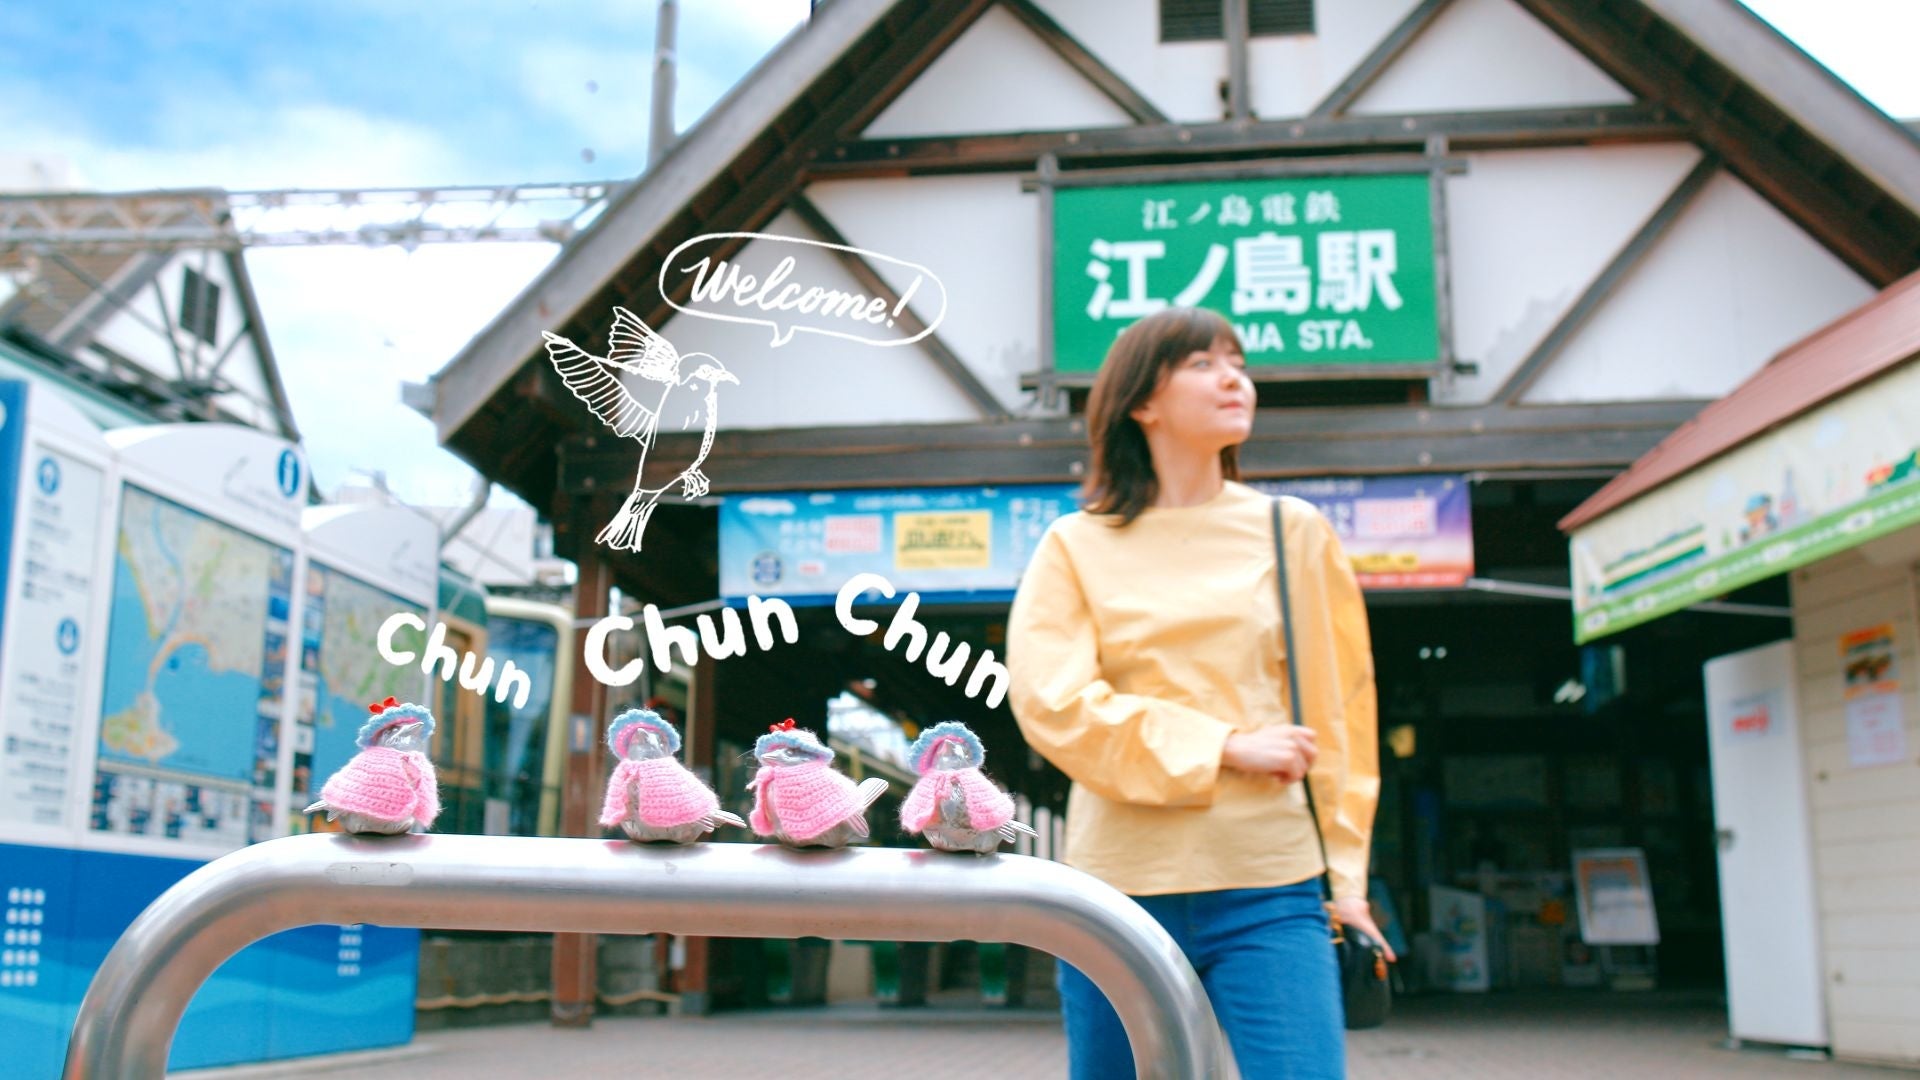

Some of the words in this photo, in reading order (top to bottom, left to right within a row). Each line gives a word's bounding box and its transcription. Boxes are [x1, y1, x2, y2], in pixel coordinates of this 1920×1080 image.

[1142, 190, 1342, 230] 江ノ島電鉄
[1086, 229, 1404, 321] 江ノ島駅
[1297, 319, 1373, 352] STA.
